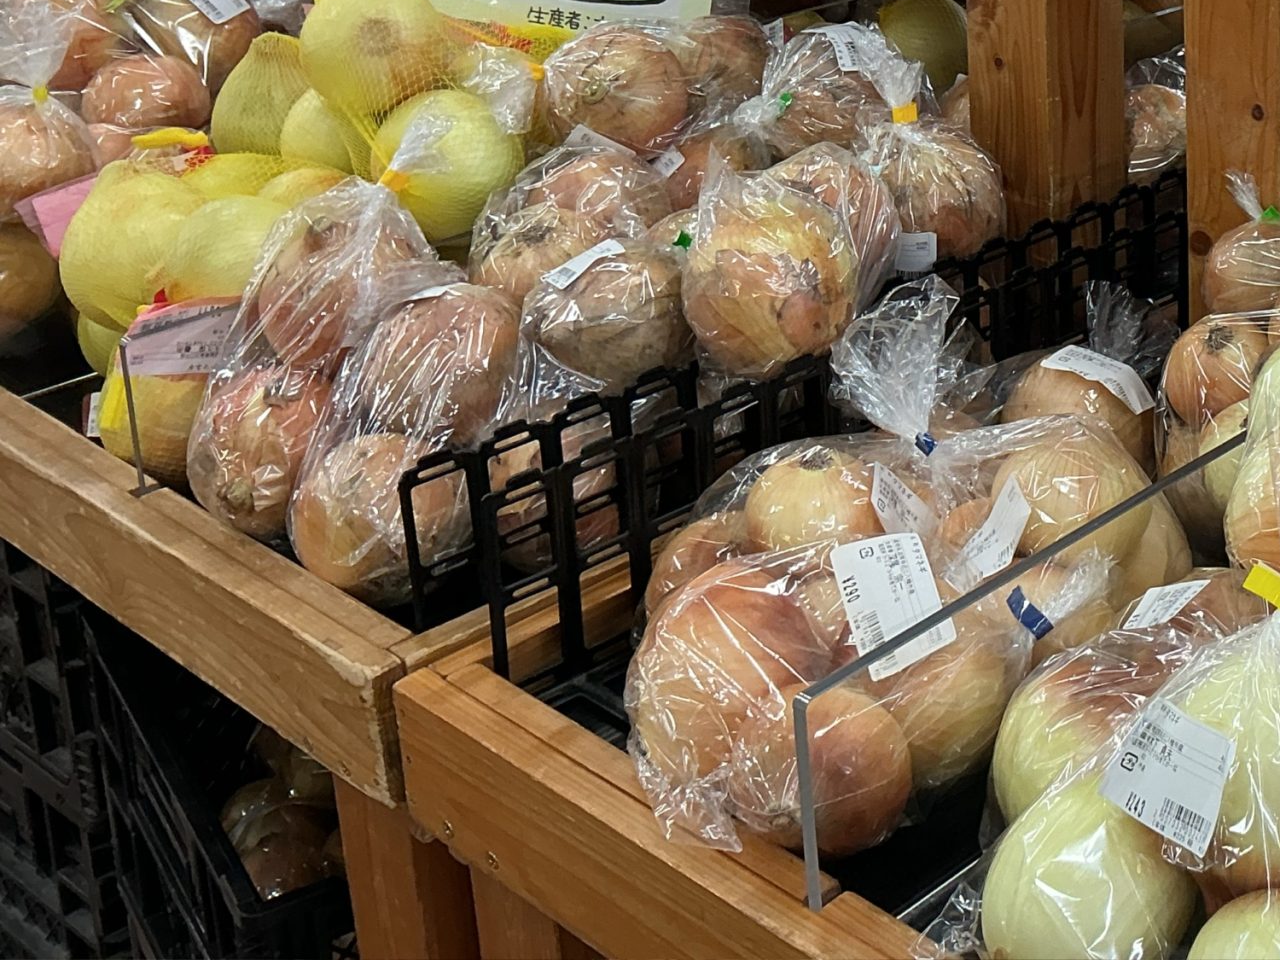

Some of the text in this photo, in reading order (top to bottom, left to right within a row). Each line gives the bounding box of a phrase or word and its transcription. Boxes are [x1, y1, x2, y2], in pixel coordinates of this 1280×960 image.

[527, 6, 606, 30] 生産者:
[840, 574, 861, 603] ¥290
[1124, 791, 1147, 817] ¥243
